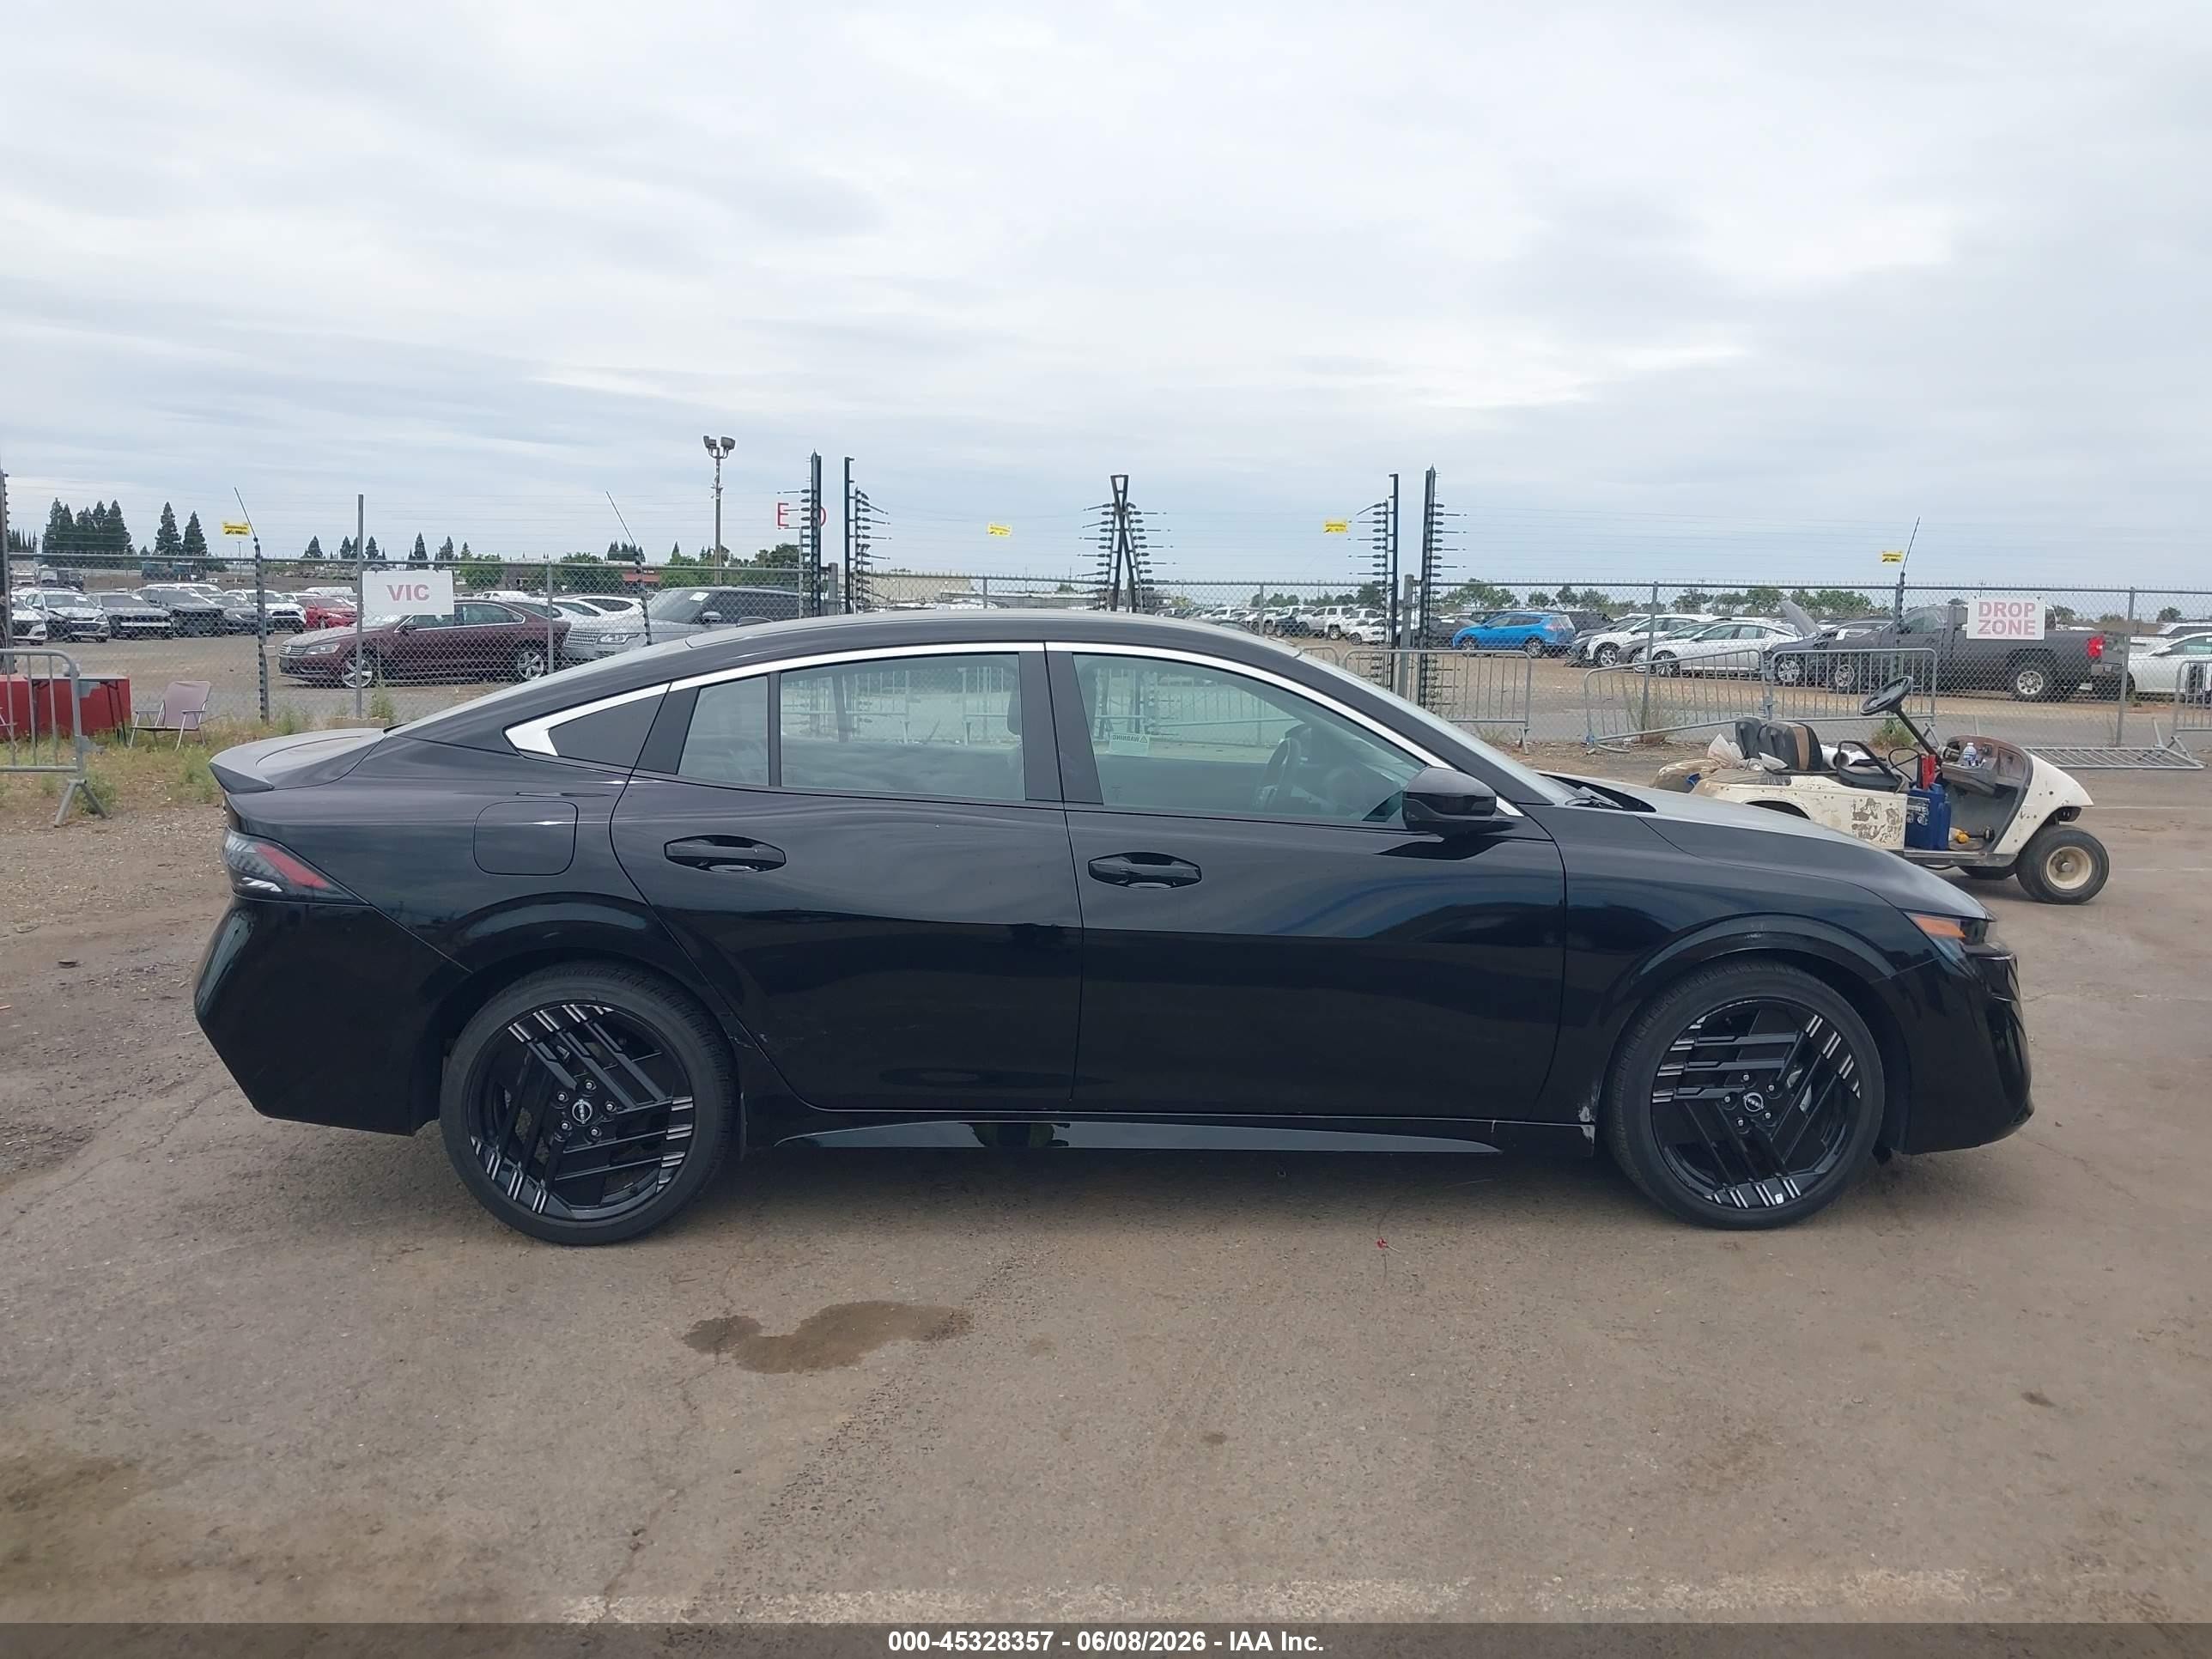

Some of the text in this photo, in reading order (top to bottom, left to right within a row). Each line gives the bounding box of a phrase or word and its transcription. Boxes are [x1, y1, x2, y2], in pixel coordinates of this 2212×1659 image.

[386, 584, 430, 601] VIC
[1978, 601, 2036, 617] DROP
[1978, 619, 2036, 635] ZONE
